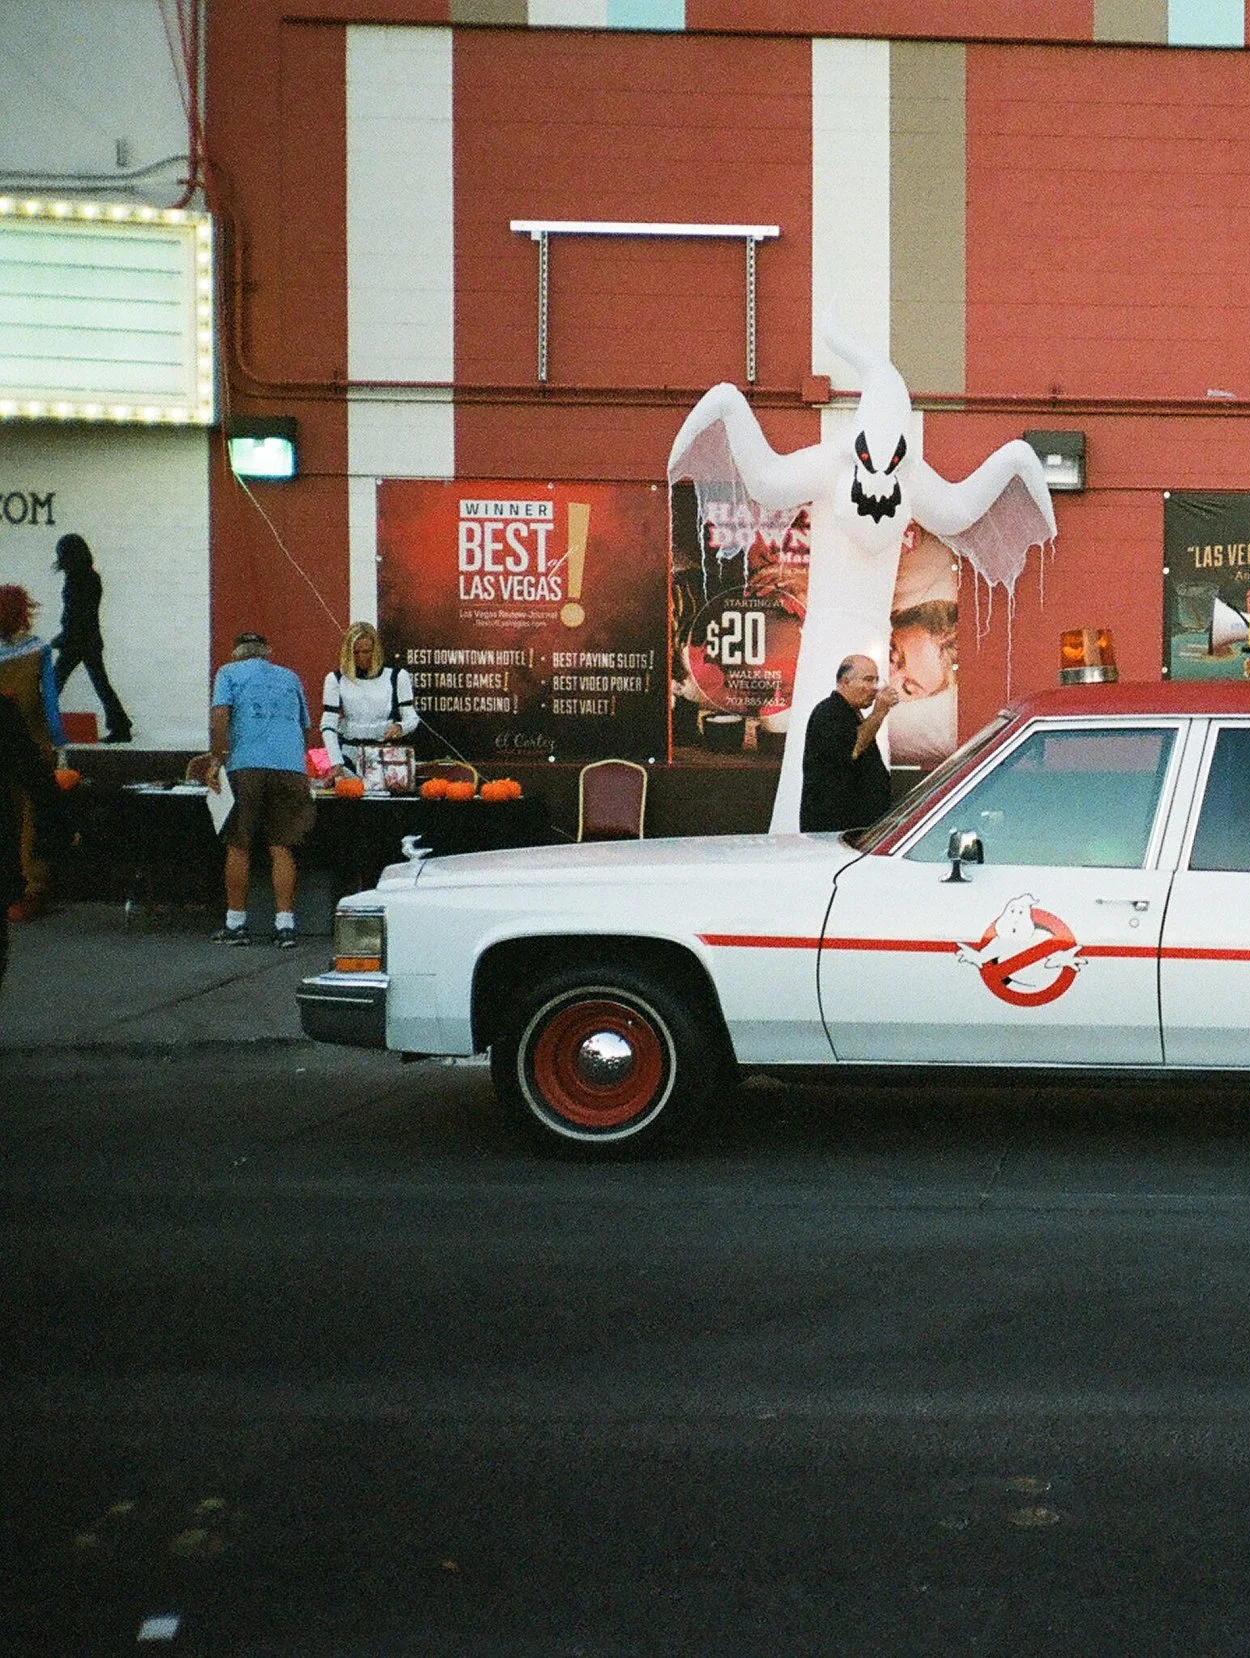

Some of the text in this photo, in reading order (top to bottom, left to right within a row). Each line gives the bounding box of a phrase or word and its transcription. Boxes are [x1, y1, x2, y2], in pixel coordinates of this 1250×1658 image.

[0, 491, 56, 525] OM
[466, 503, 547, 516] WINNER
[458, 521, 554, 573] BEST
[459, 575, 562, 600] LAS VEGAS
[725, 599, 771, 608] STARTING
[706, 611, 766, 665] $20
[407, 649, 432, 665] BEST
[434, 650, 495, 665] DOWNTOWN
[552, 652, 578, 668] BEST
[580, 653, 615, 668] PAYING
[434, 674, 463, 688] TABLE
[553, 675, 578, 691] BEST
[579, 676, 608, 691] VIDEO
[728, 680, 782, 689] WELCOME
[414, 696, 433, 711] EST
[434, 697, 471, 711] LOCALS
[553, 698, 578, 714] BEST
